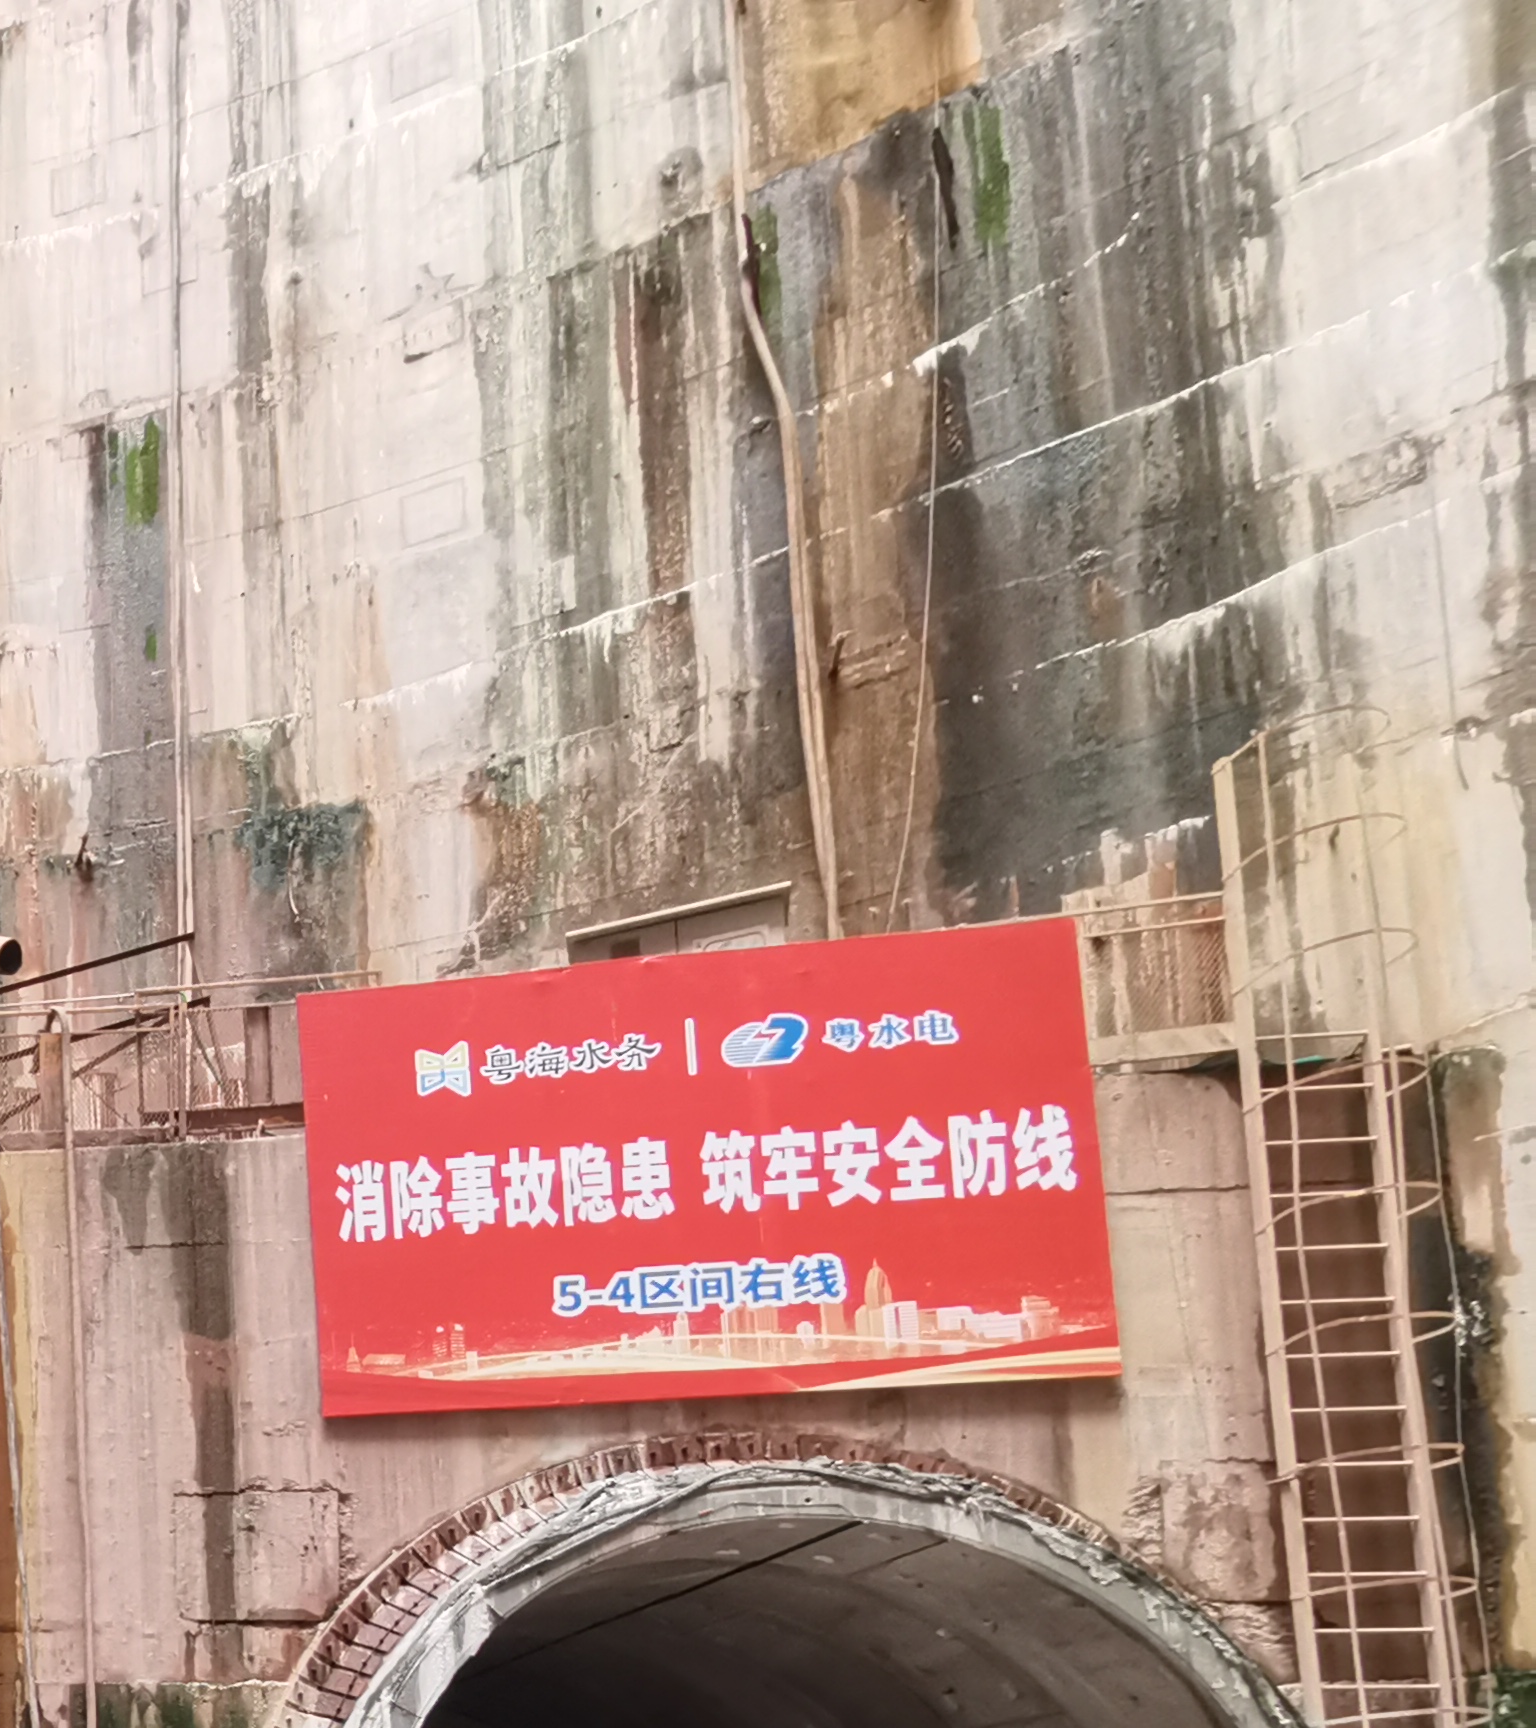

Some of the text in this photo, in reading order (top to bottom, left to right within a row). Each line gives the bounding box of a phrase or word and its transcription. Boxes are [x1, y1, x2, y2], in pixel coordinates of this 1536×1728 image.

[480, 1032, 662, 1085] 粤海水务
[822, 1010, 959, 1051] 粤水电
[334, 1104, 1078, 1243] 消除事故隐患 筑牢安全防线
[552, 1253, 847, 1316] 5-4区间右线
